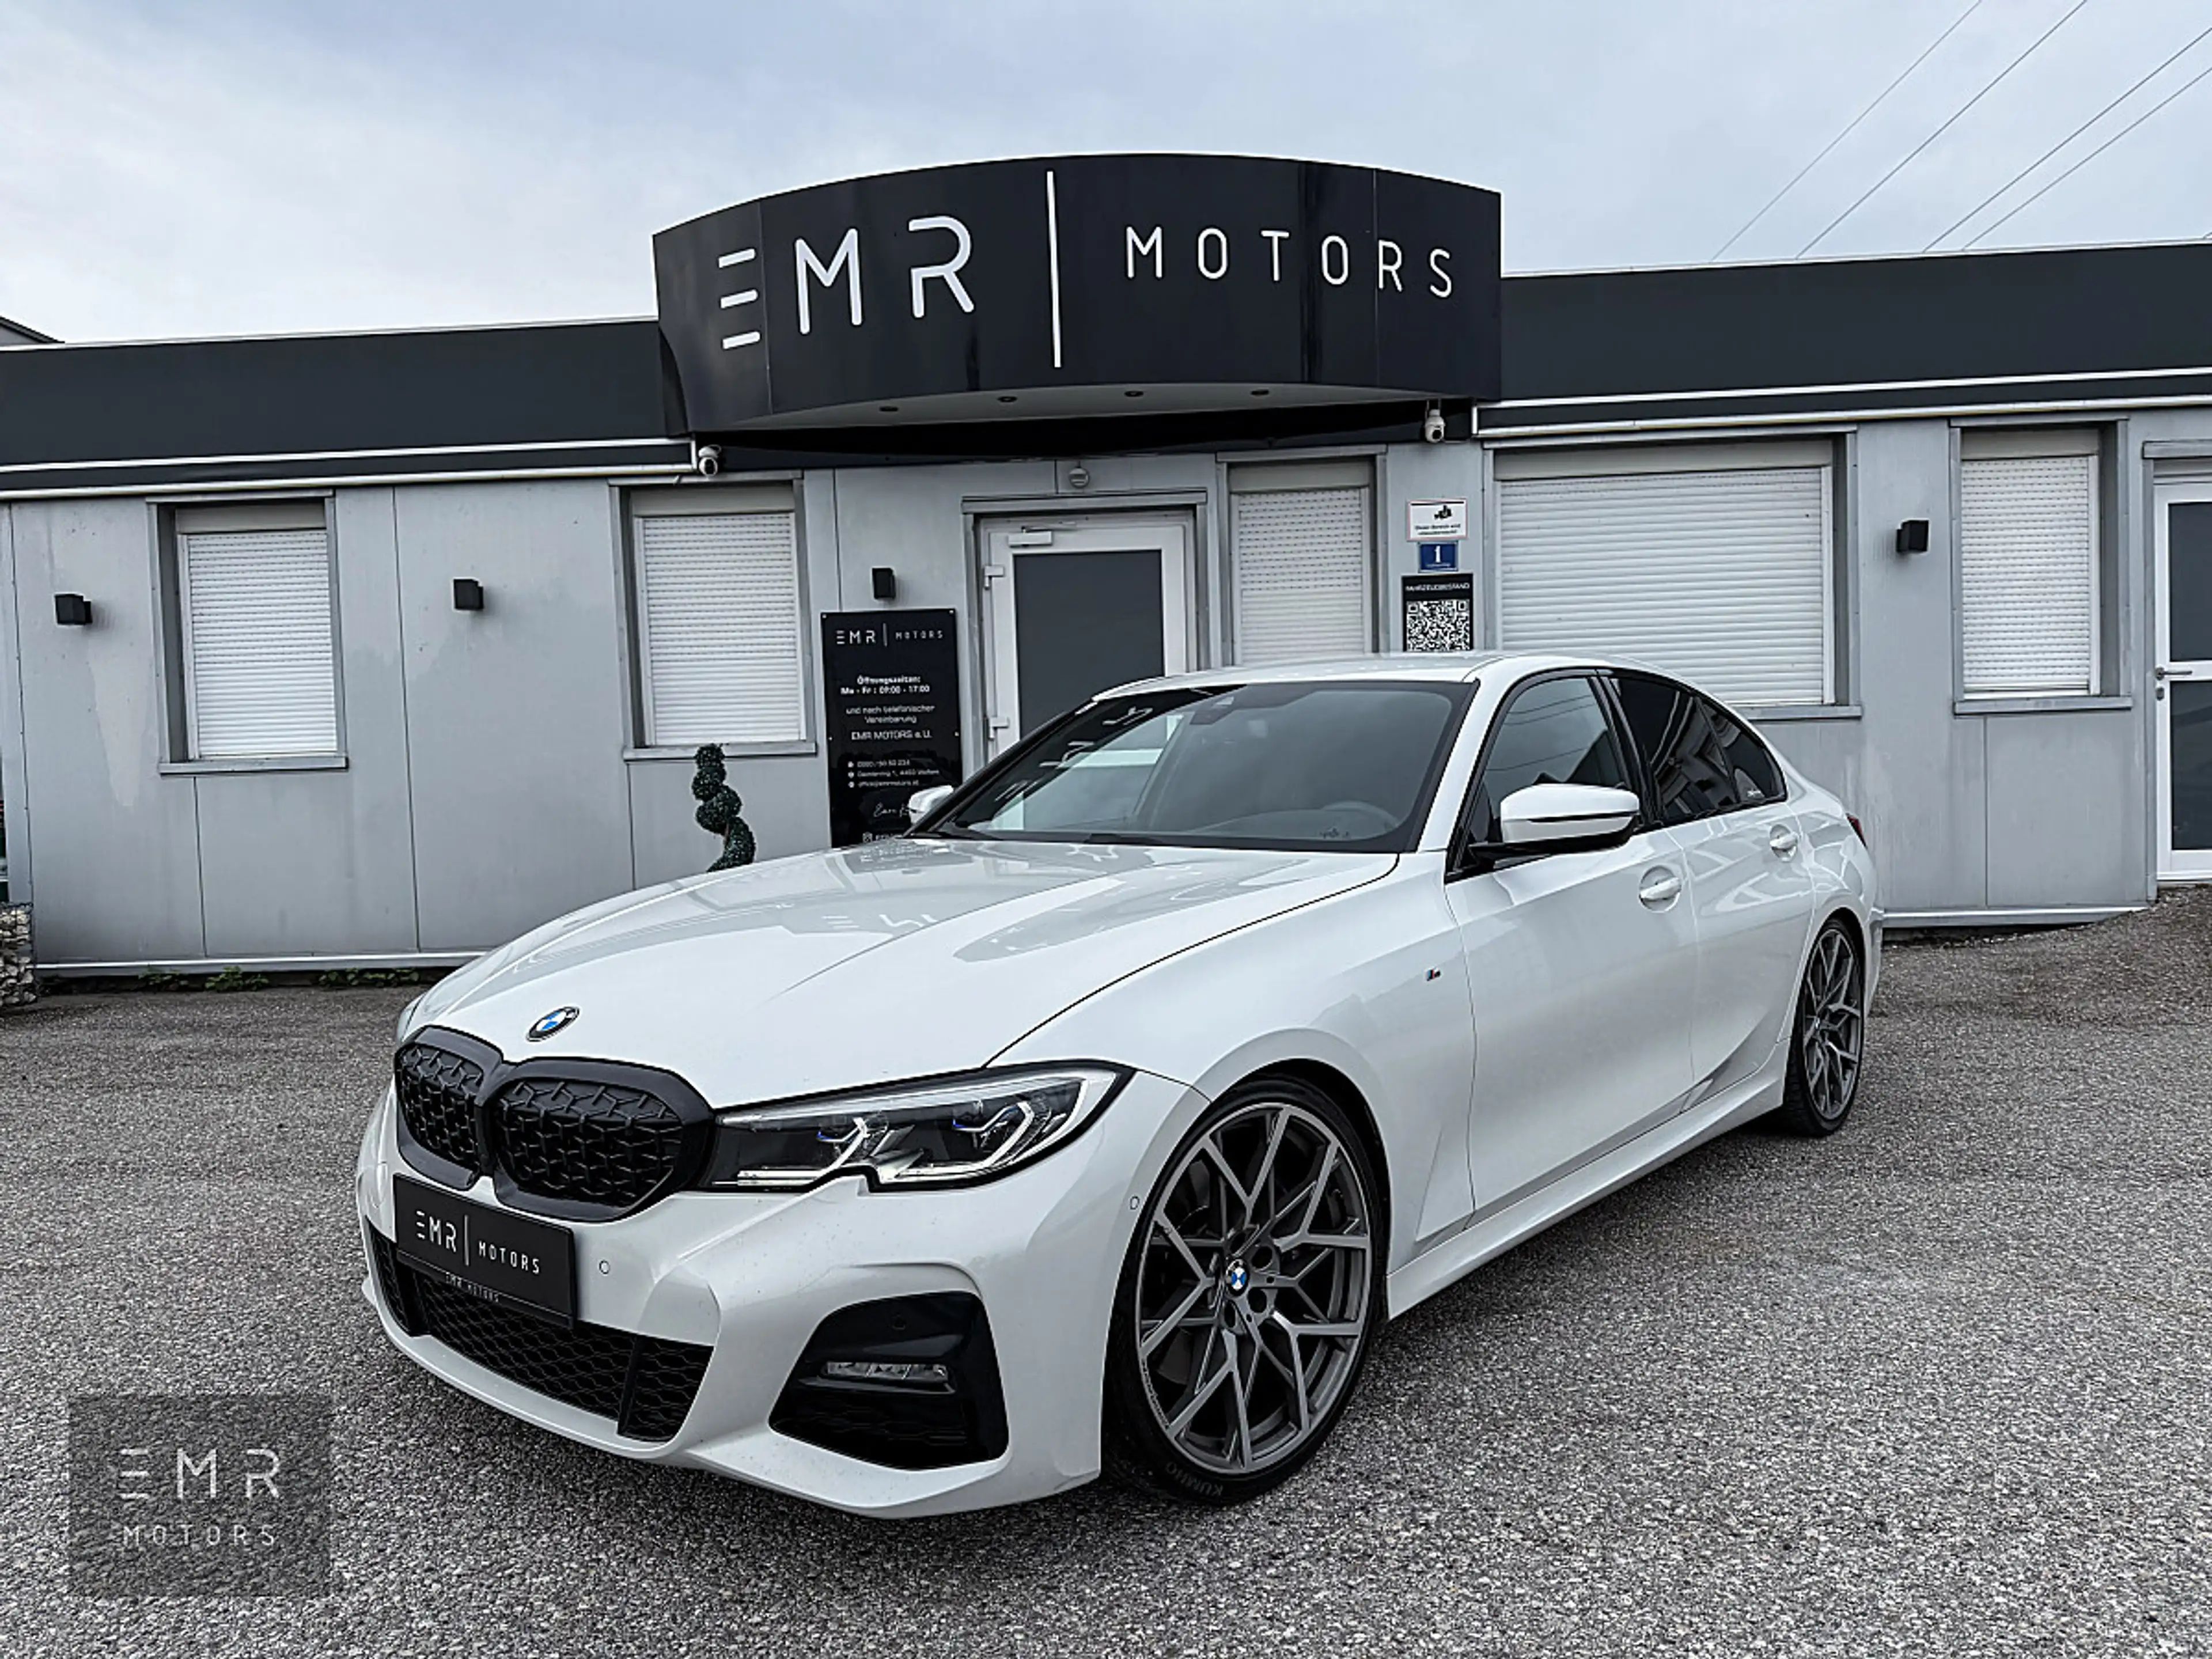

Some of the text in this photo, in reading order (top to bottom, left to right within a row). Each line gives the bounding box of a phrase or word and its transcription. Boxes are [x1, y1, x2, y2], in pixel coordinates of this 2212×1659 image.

[718, 215, 1452, 349] EMR MOTORS
[1434, 545, 1441, 563] 1
[836, 630, 944, 645] EMR MOTORS
[873, 730, 914, 740] MOTORS
[416, 1210, 540, 1275] EMR MOTORS
